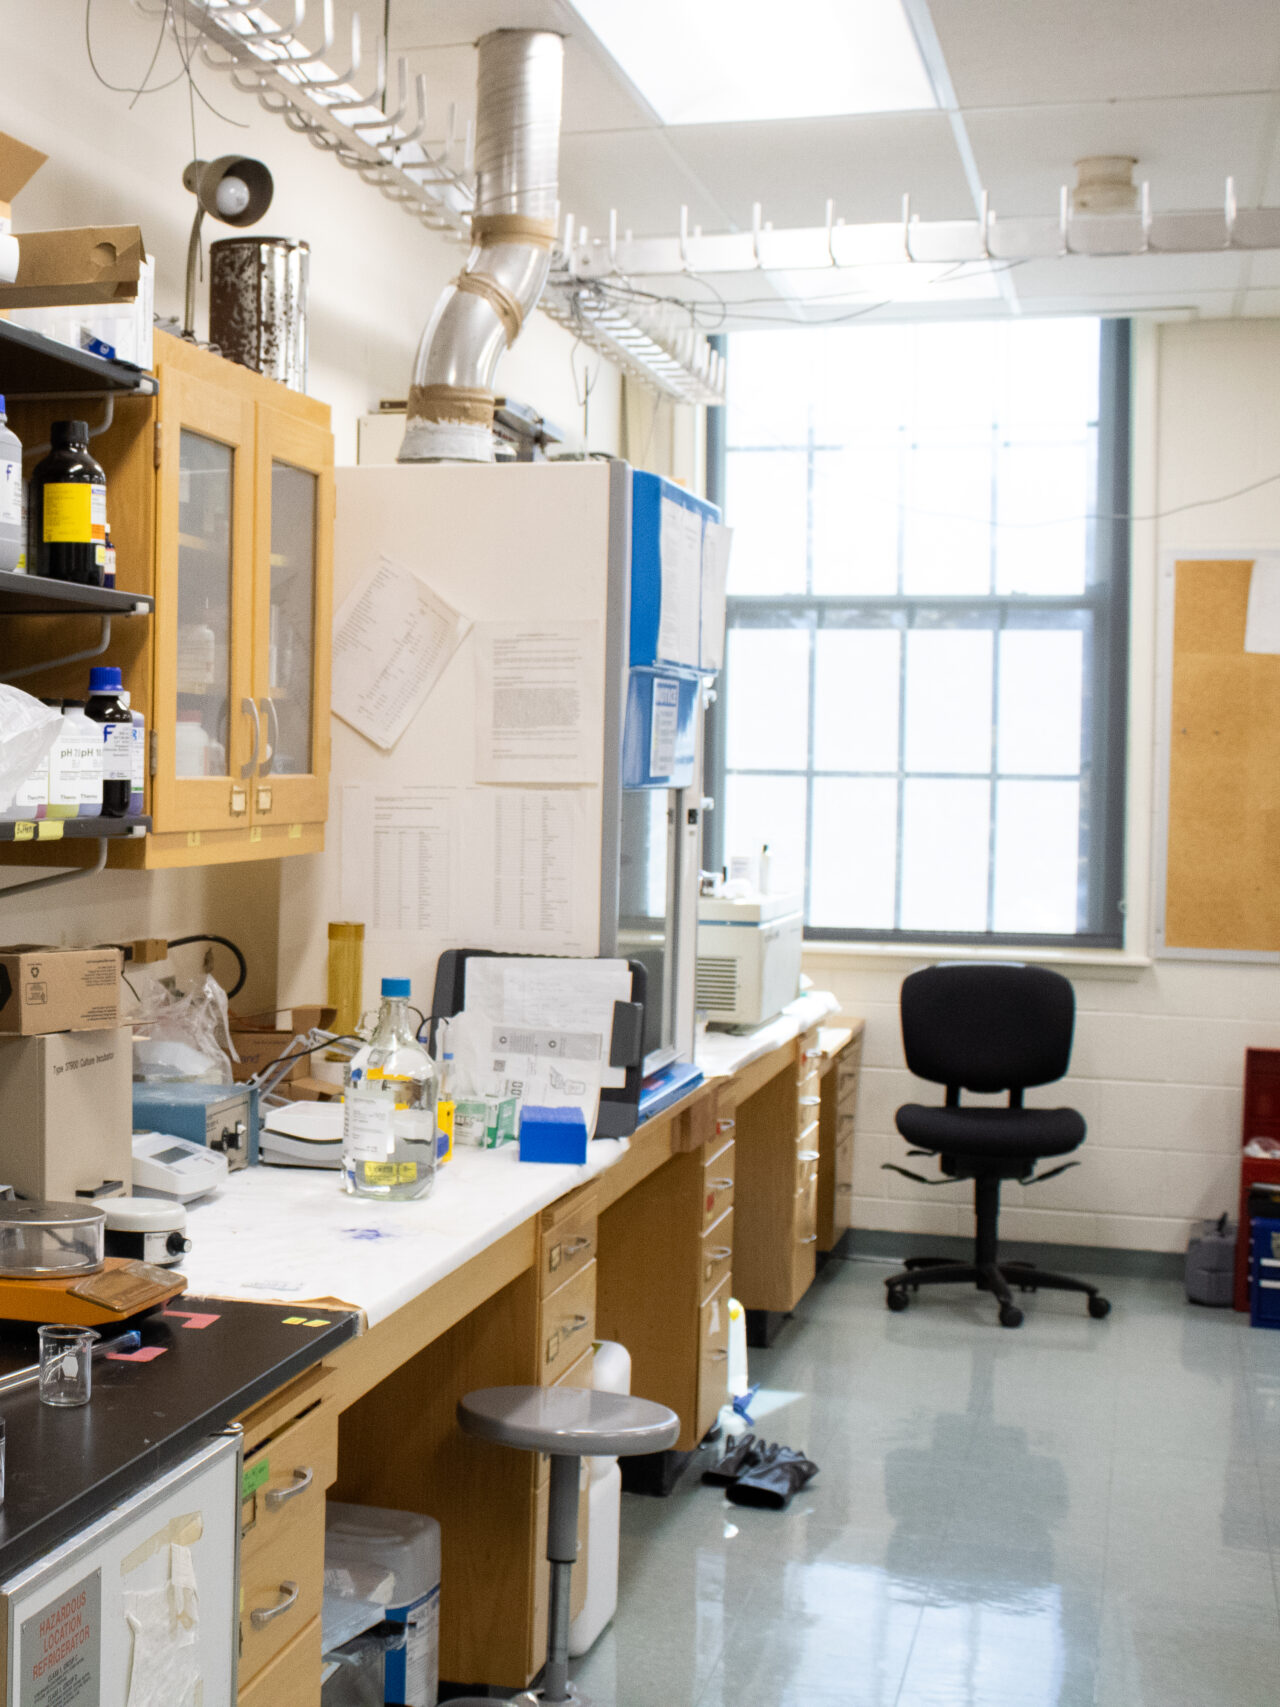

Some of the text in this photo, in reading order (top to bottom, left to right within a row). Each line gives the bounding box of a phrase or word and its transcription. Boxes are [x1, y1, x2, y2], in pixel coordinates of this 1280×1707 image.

[103, 724, 116, 743] F
[61, 748, 72, 759] pH
[81, 748, 94, 759] pH
[40, 1591, 87, 1638] HAZARDOUS
[43, 1612, 82, 1653] LOCATION
[32, 1624, 90, 1681] REFRIGERATOR
